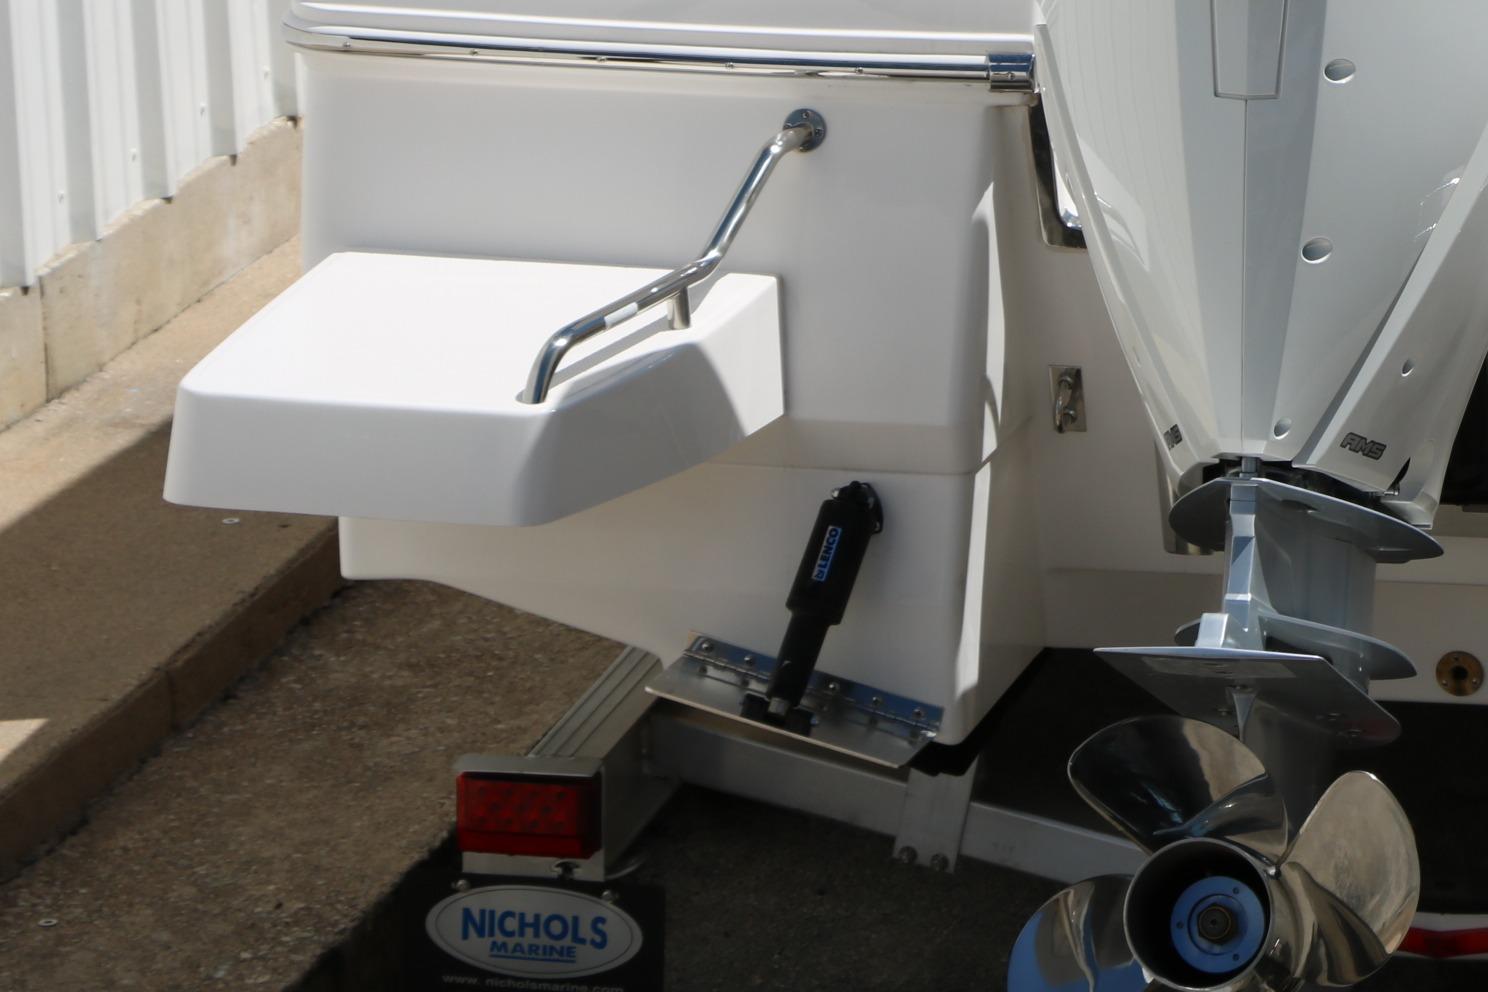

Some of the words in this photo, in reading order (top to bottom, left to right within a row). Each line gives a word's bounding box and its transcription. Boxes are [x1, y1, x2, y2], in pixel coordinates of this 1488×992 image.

[1340, 431, 1387, 461] AMS
[818, 527, 840, 569] LENCO
[461, 907, 608, 951] NICHOLS
[490, 940, 577, 958] MARINE
